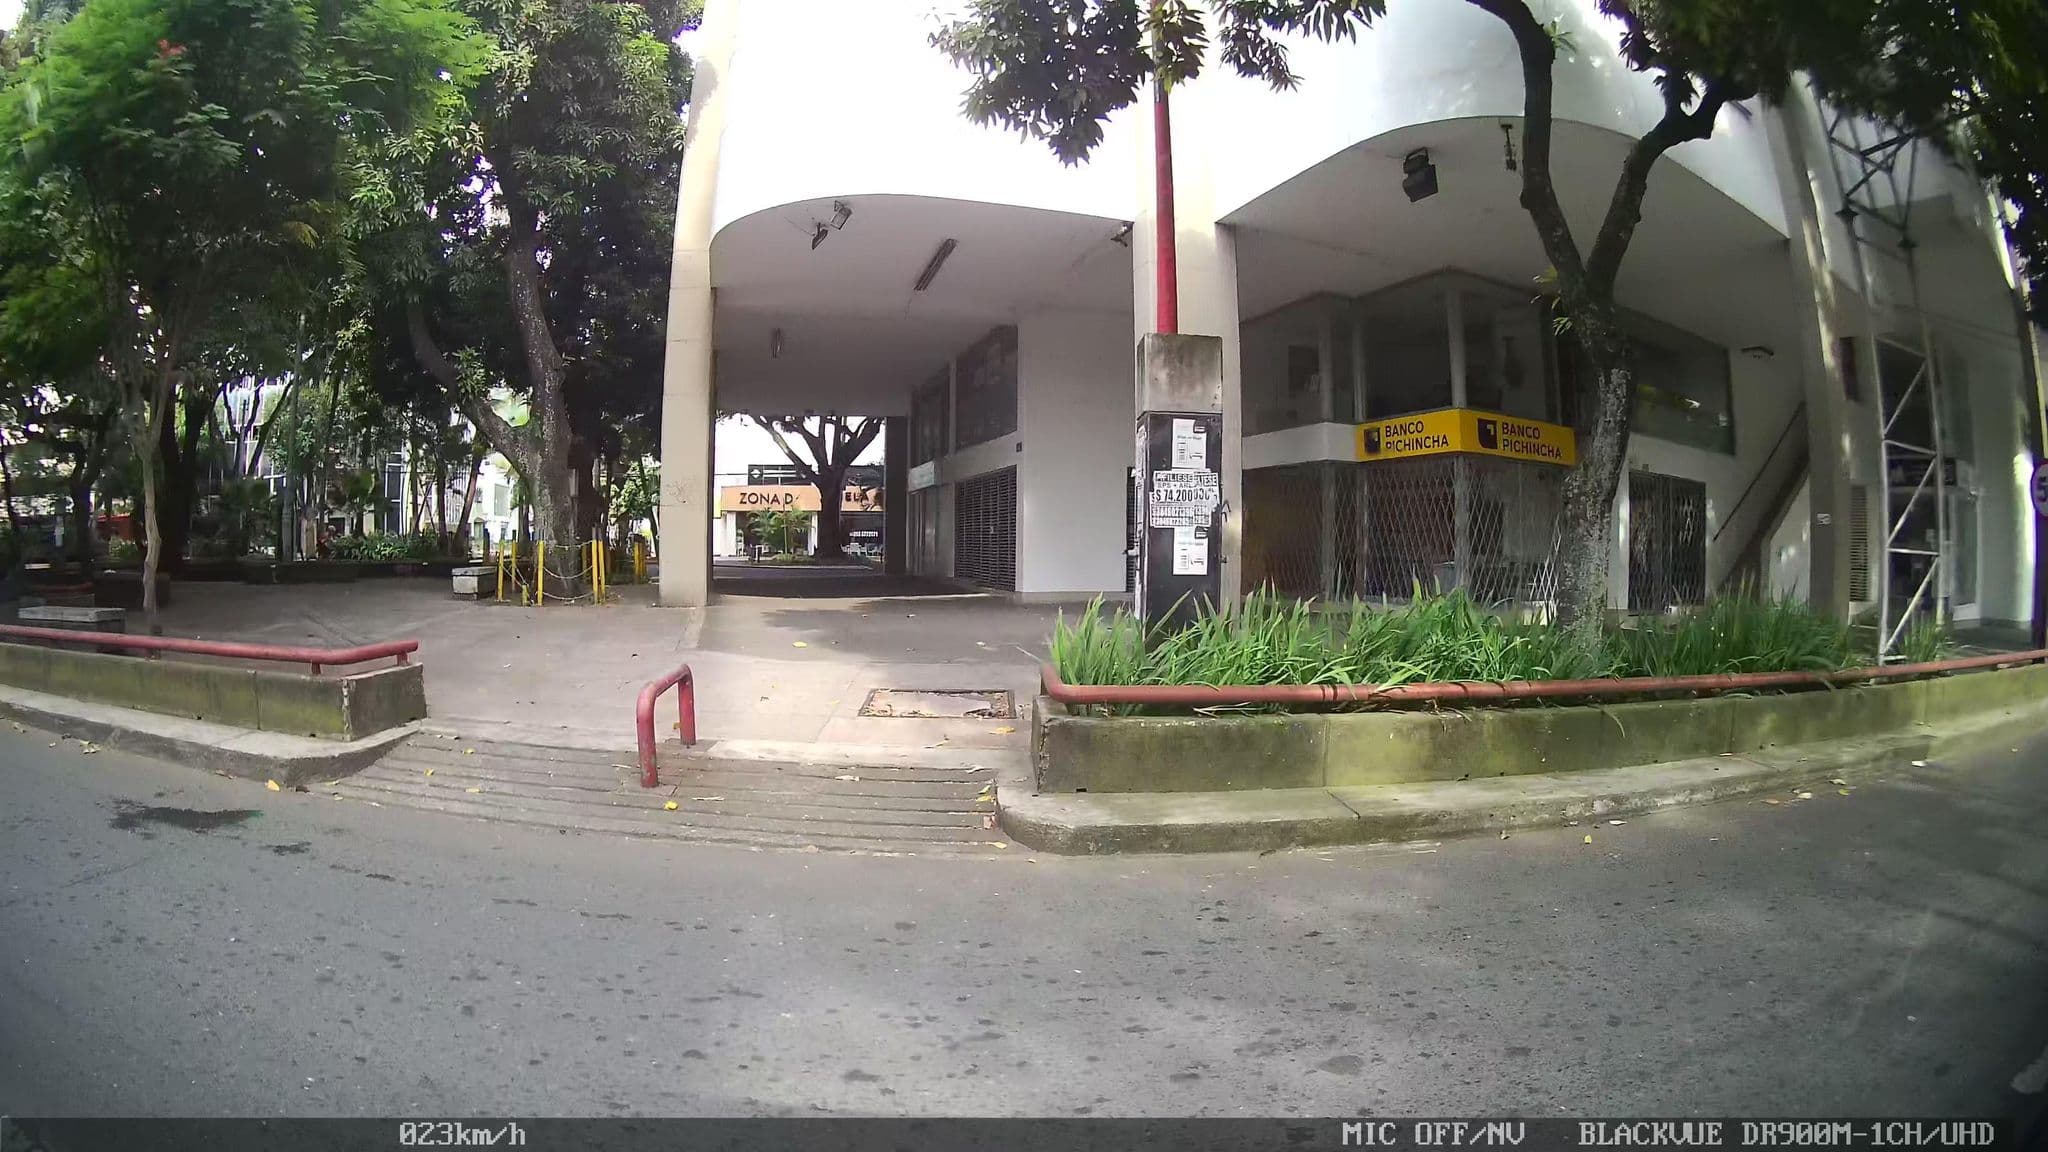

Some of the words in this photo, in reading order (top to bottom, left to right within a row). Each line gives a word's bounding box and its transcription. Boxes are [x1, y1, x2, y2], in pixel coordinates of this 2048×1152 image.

[1385, 421, 1424, 437] BANCO
[1502, 422, 1541, 440] BANCO
[1385, 434, 1449, 452] PICHINCHA
[1502, 438, 1562, 459] PICHINCHA
[739, 492, 780, 505] ZONA
[1163, 489, 1193, 502] 74.200
